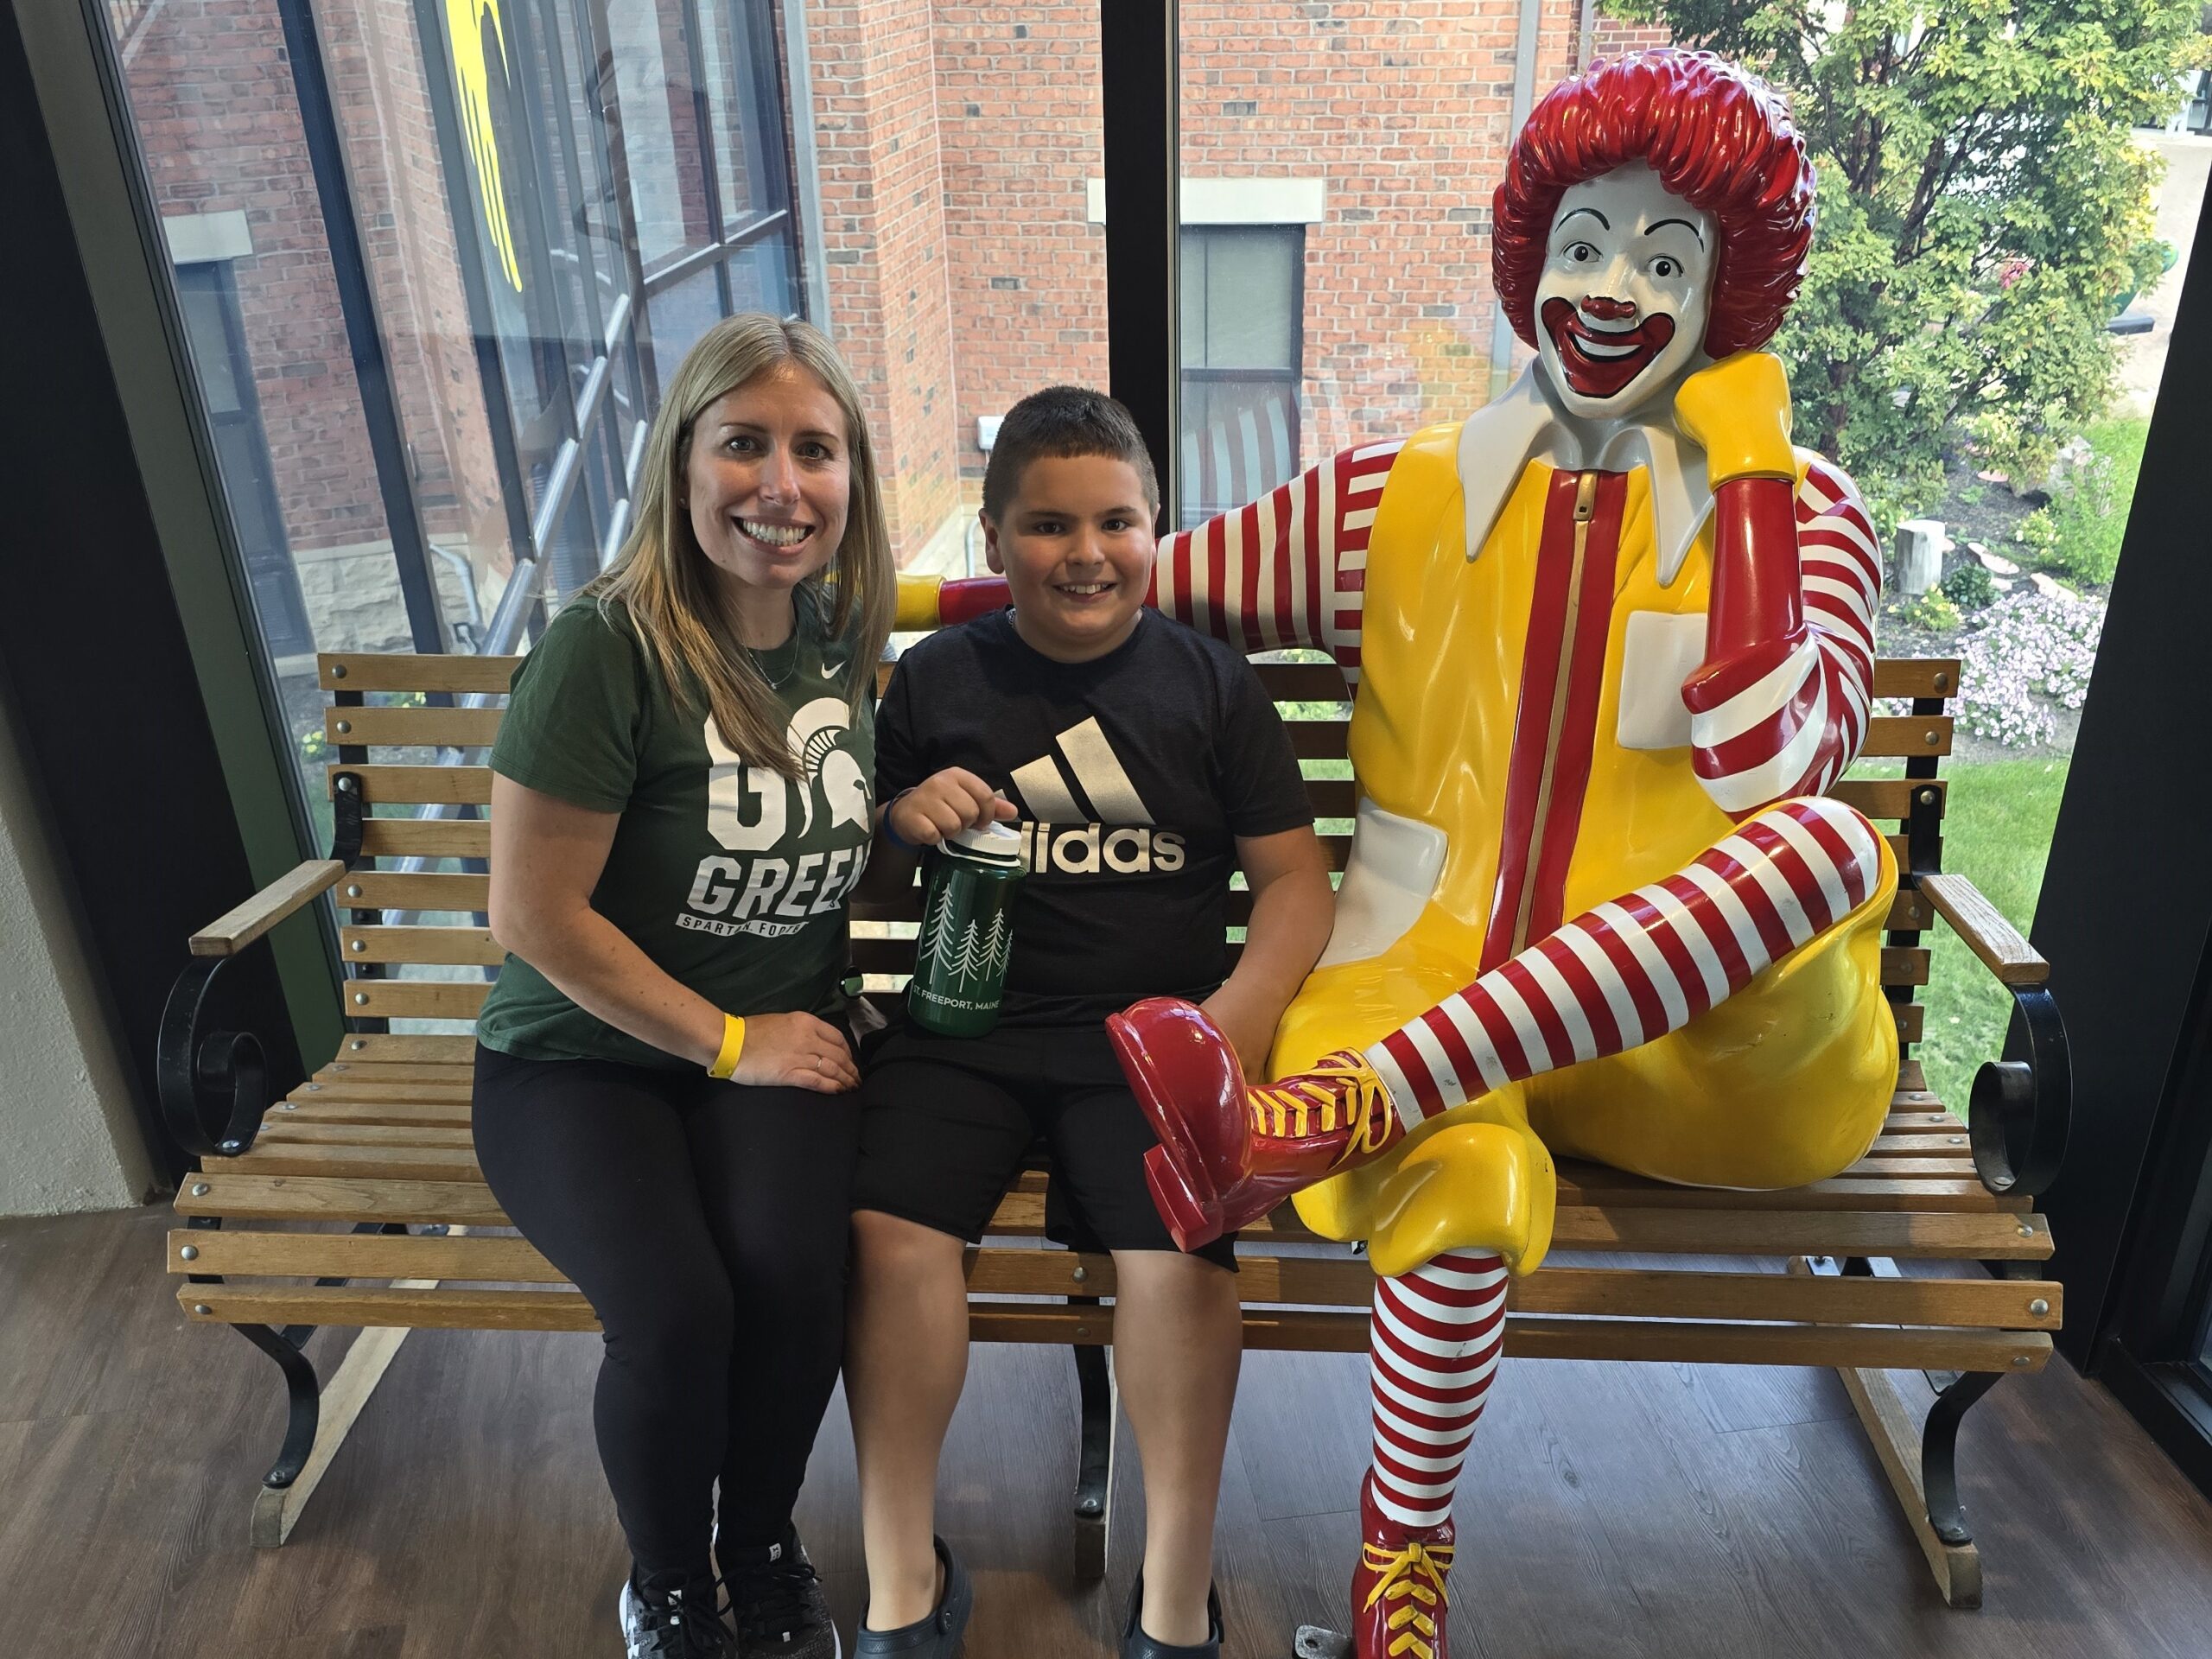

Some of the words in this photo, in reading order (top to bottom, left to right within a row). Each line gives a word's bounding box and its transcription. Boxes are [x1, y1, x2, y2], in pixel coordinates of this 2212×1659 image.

[1020, 821, 1185, 874] idas
[921, 989, 973, 1011] FREEPORT,
[975, 1000, 1001, 1010] MAINE
